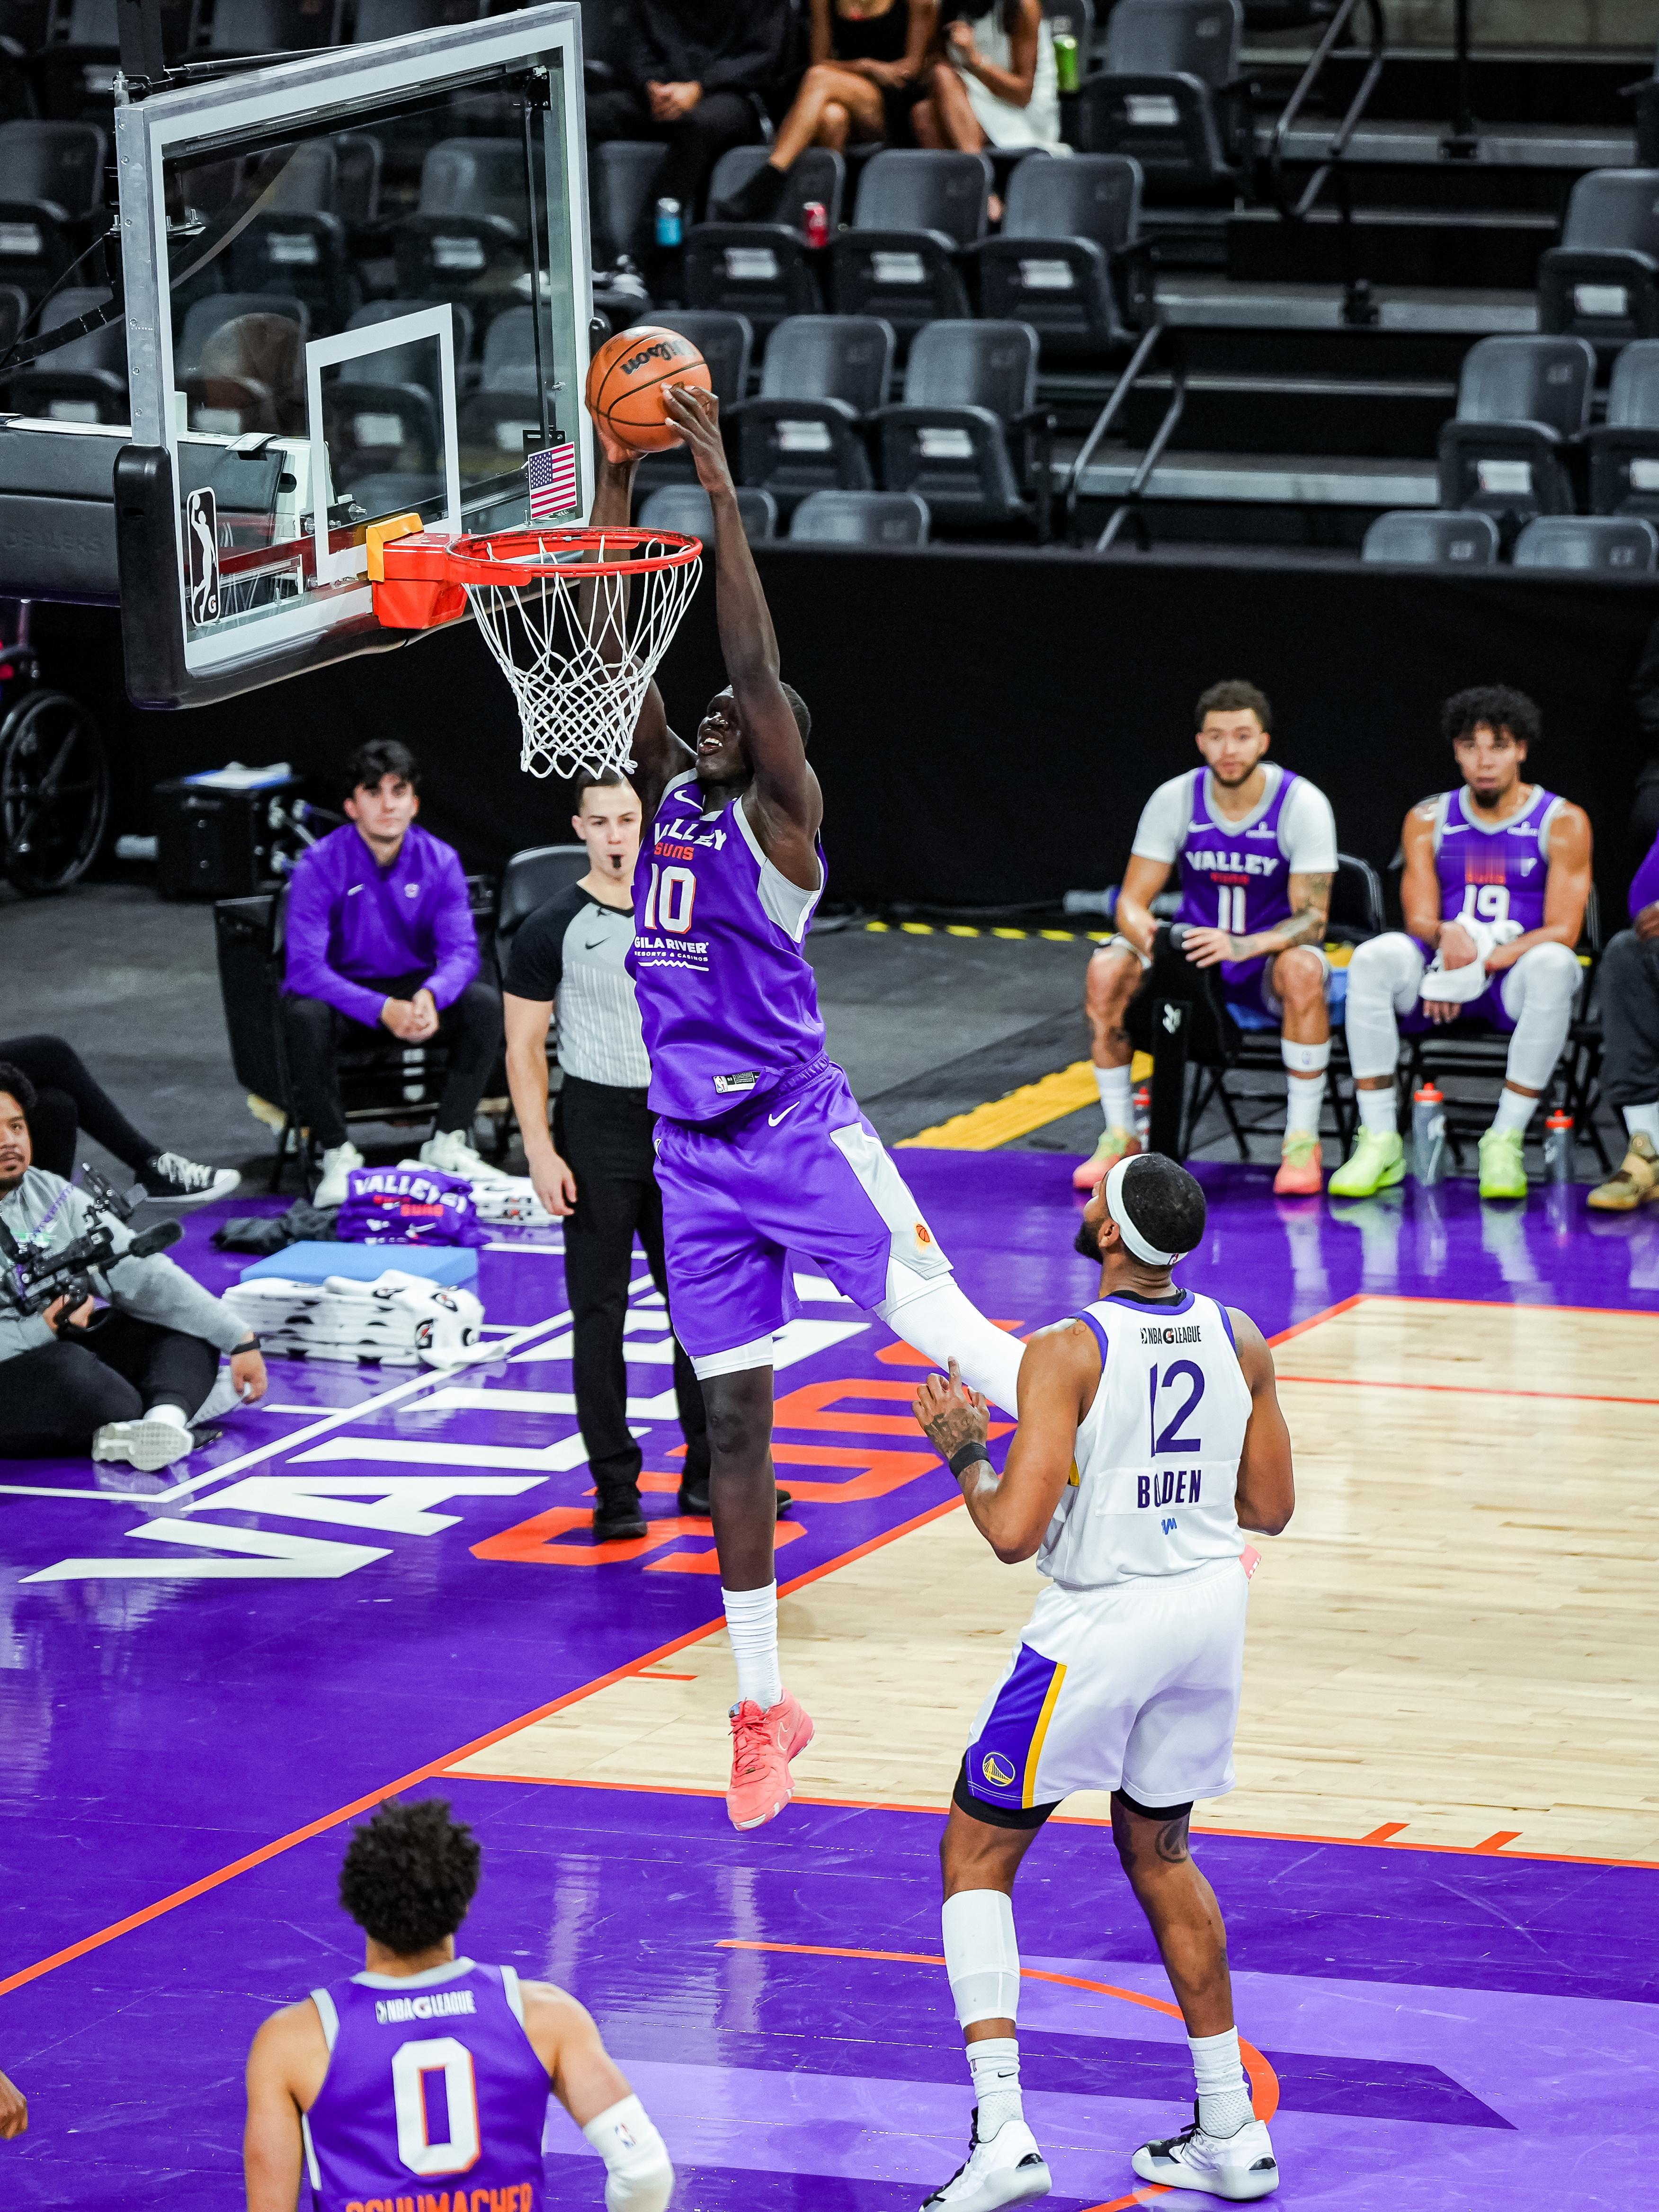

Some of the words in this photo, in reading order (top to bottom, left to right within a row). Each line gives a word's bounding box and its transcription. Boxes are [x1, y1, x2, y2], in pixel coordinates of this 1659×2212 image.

[653, 842, 695, 861] SUNS
[654, 818, 727, 851] VLLEY
[1185, 850, 1280, 876] VALLEY
[644, 863, 696, 934] 10
[1217, 884, 1247, 934] 11
[1462, 884, 1510, 921] 19
[634, 937, 665, 949] GILA
[665, 938, 708, 954] RIVER
[677, 953, 708, 962] CASINOS
[1148, 1327, 1162, 1344] NBA
[1174, 1326, 1202, 1344] LEAGUE
[1150, 1359, 1205, 1458] 12
[18, 1272, 872, 1584] VALLE
[473, 1319, 1028, 1575] SUN
[392, 2036, 482, 2176] 0
[346, 2182, 533, 2212] MACHER
